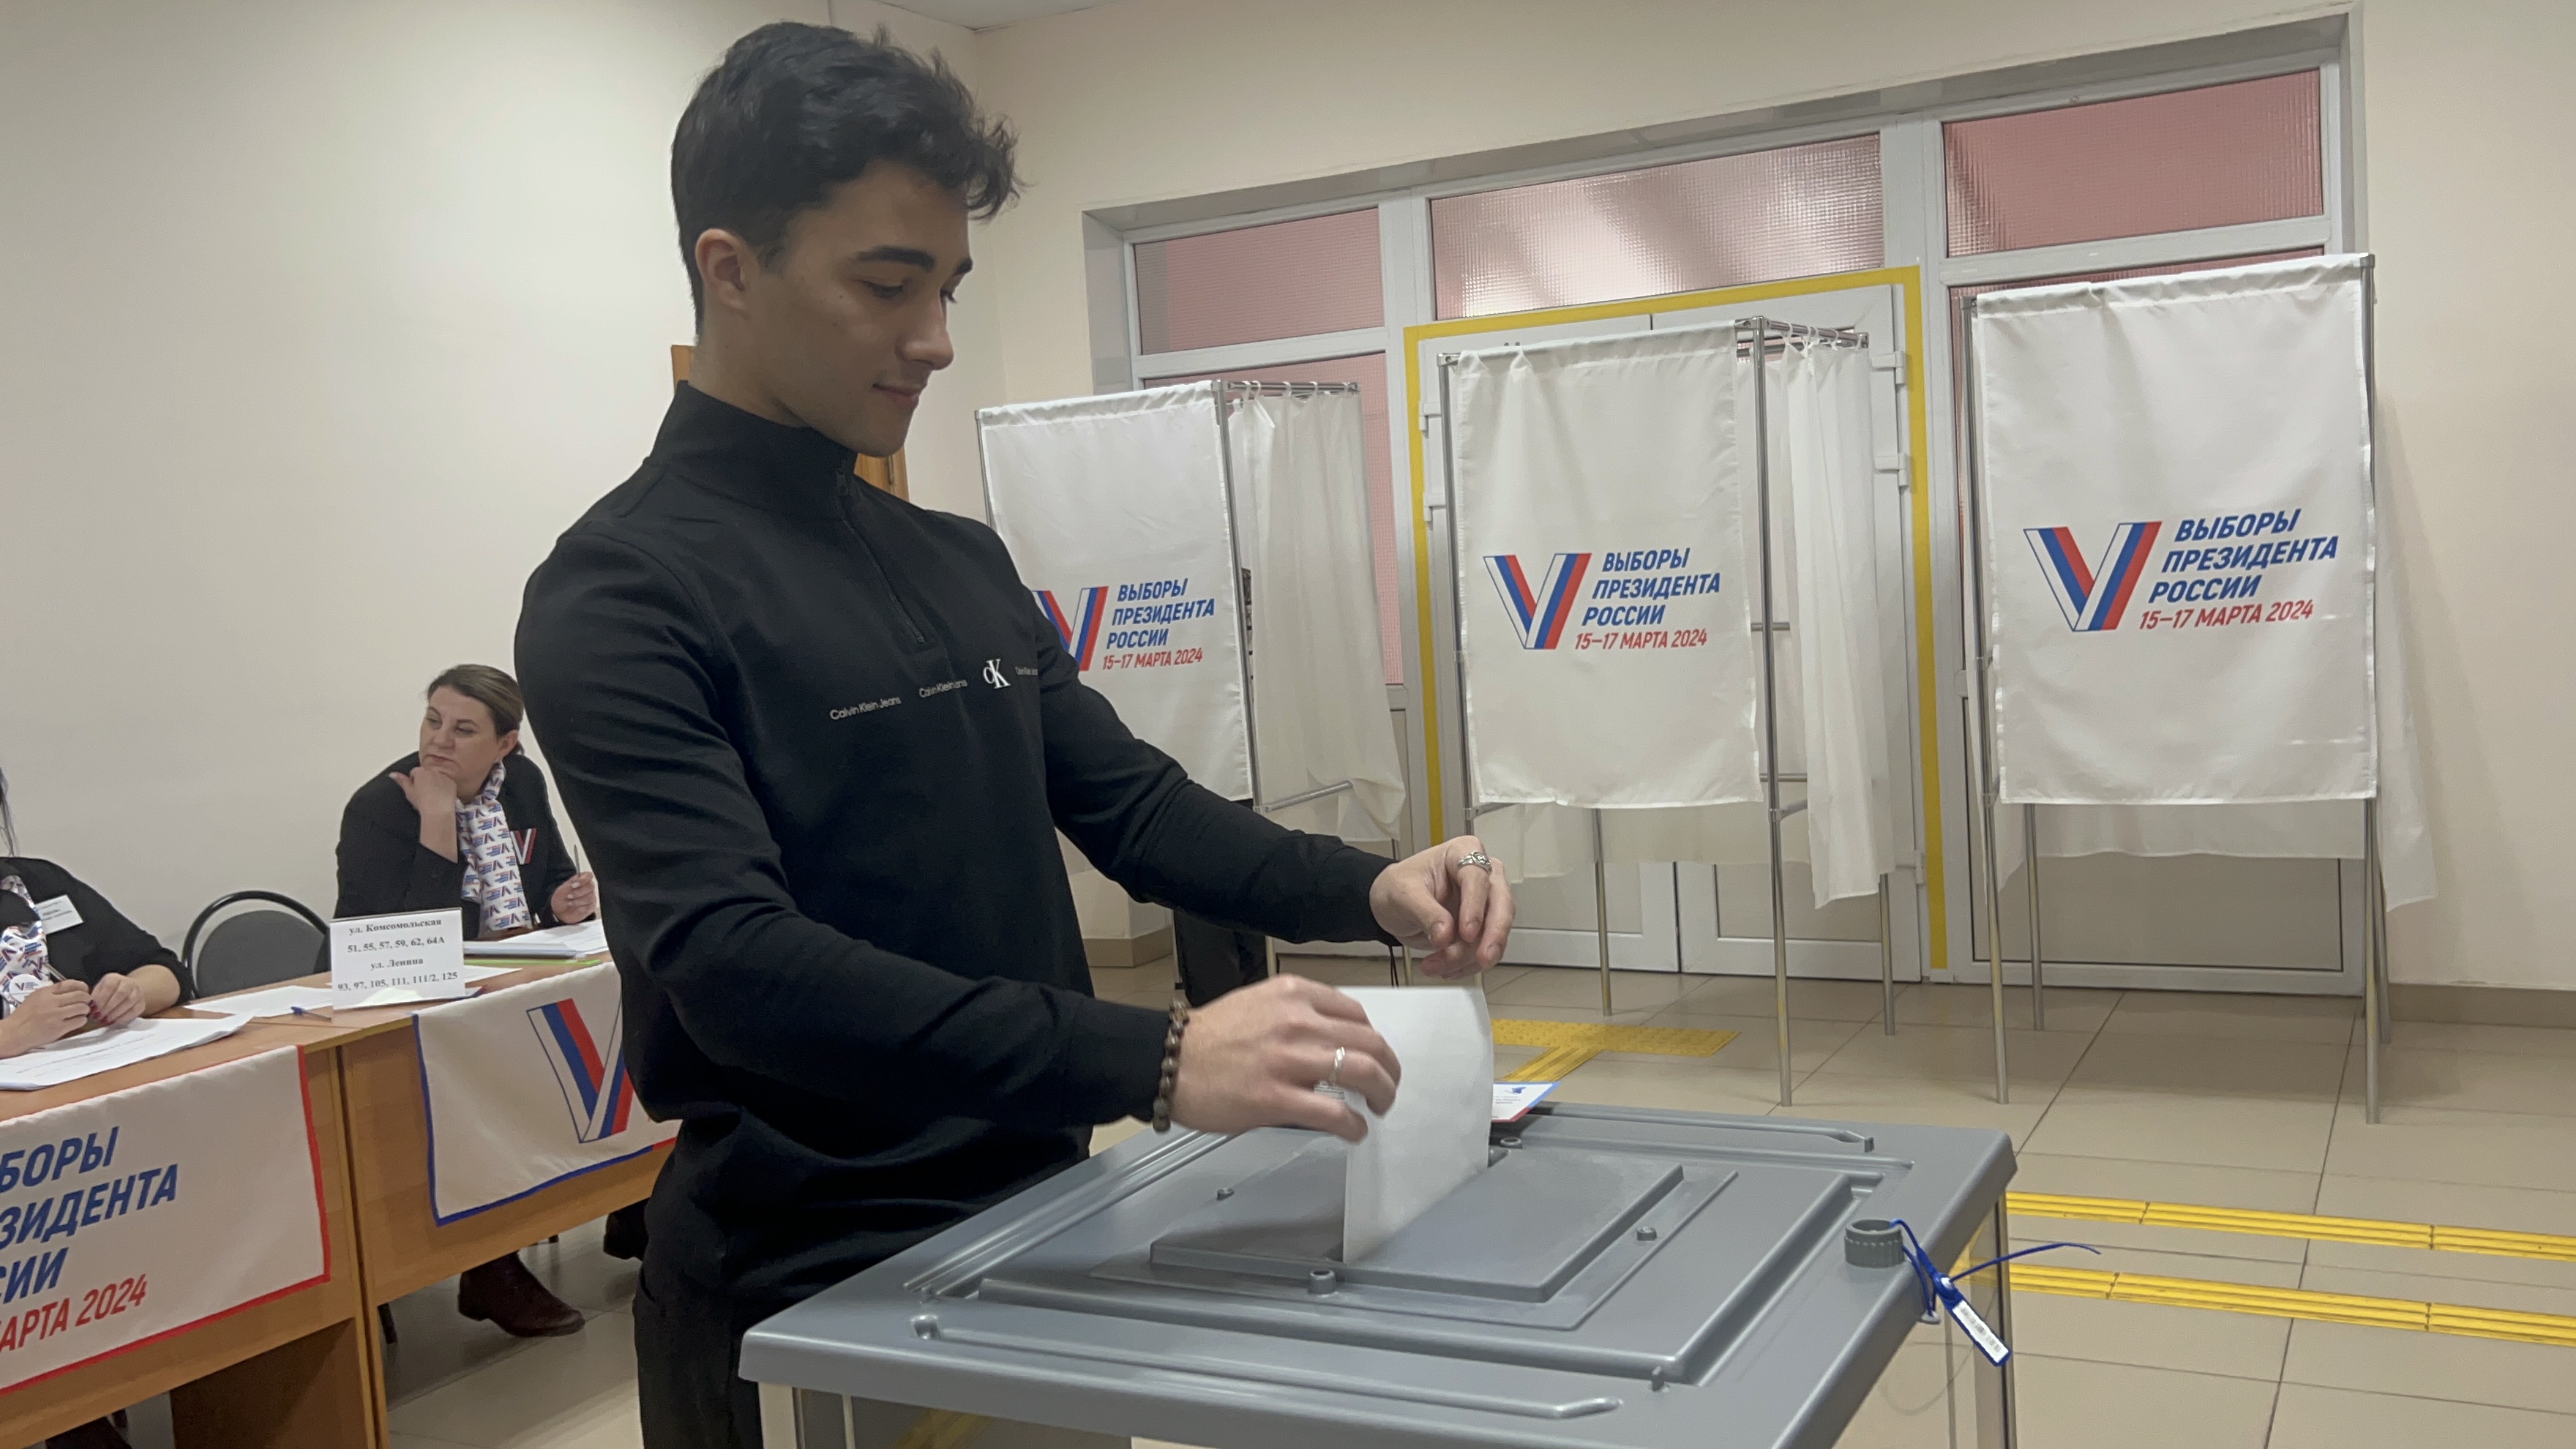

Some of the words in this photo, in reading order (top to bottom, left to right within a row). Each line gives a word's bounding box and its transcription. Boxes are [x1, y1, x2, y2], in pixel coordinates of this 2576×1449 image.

[2174, 508, 2302, 543] ВЫБОРЫ
[1601, 547, 1690, 572] ВЫБОРЫ
[2161, 535, 2339, 574] ПРЕЗИДЕНТА
[1117, 578, 1188, 602] ВЫБОРЫ
[1592, 573, 1720, 600] ПРЕЗИДЕНТА
[2148, 574, 2262, 604] РОССИИ
[1112, 599, 1215, 626] ПРЕЗИДЕНТА
[1581, 604, 1666, 626] РОССИИ
[2195, 603, 2261, 628] МАРТА
[2265, 598, 2314, 623] 2024
[1107, 628, 1169, 650] РОССИИ
[1620, 631, 1667, 649] МАРТА
[1671, 628, 1707, 648] 2024
[1134, 651, 1172, 669] МАРТА
[1174, 648, 1203, 666] 2024
[830, 705, 859, 720] Calvin
[858, 700, 878, 713] Klein
[879, 696, 902, 709] Jeans
[349, 926, 363, 936] ул.
[366, 918, 442, 933] Комсомольская
[370, 961, 384, 971] ул.
[387, 958, 424, 969] Ленина
[443, 972, 458, 981] 125
[0, 1298, 70, 1352] АРТА
[75, 1273, 148, 1327] 2024
